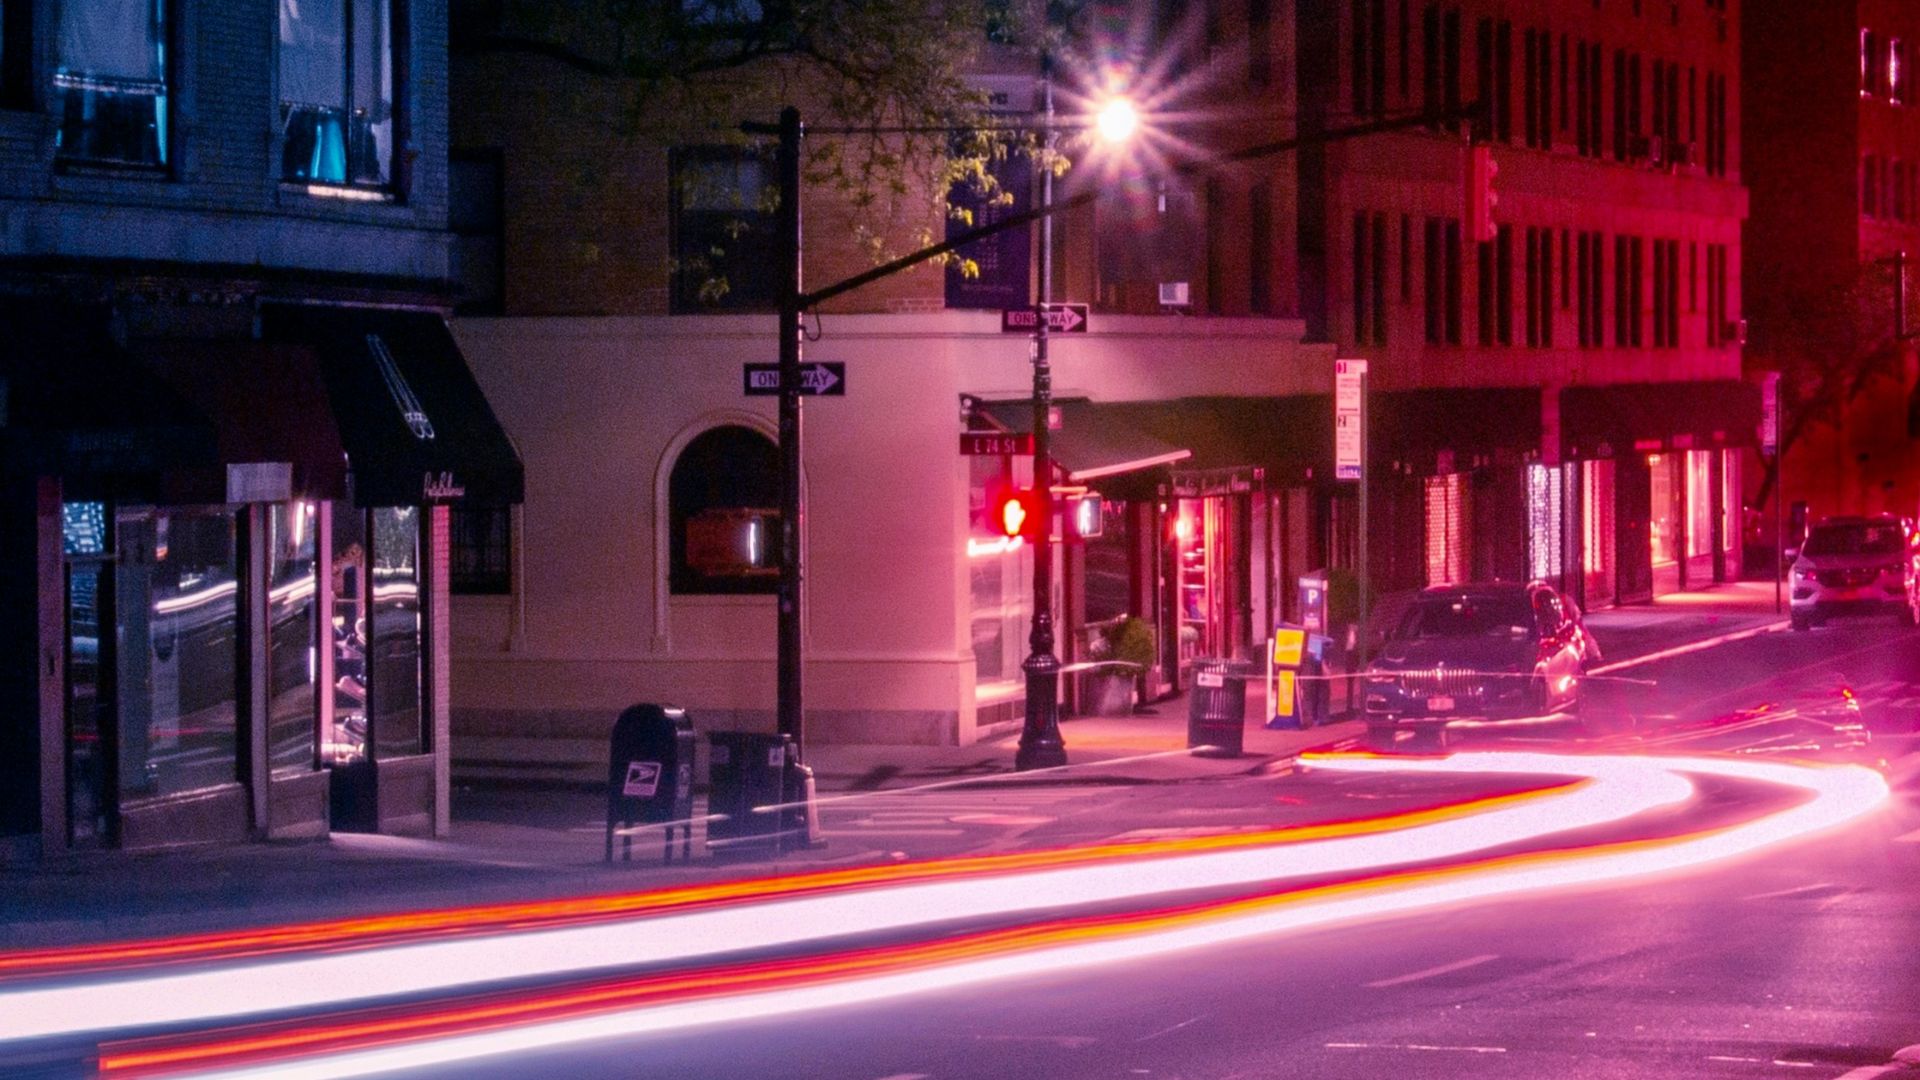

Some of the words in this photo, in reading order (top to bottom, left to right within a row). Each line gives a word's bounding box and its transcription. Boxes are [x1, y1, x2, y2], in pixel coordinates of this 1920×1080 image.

[1050, 314, 1075, 324] WAY
[758, 372, 779, 386] ON
[801, 372, 828, 386] WAY
[1308, 589, 1318, 604] P
